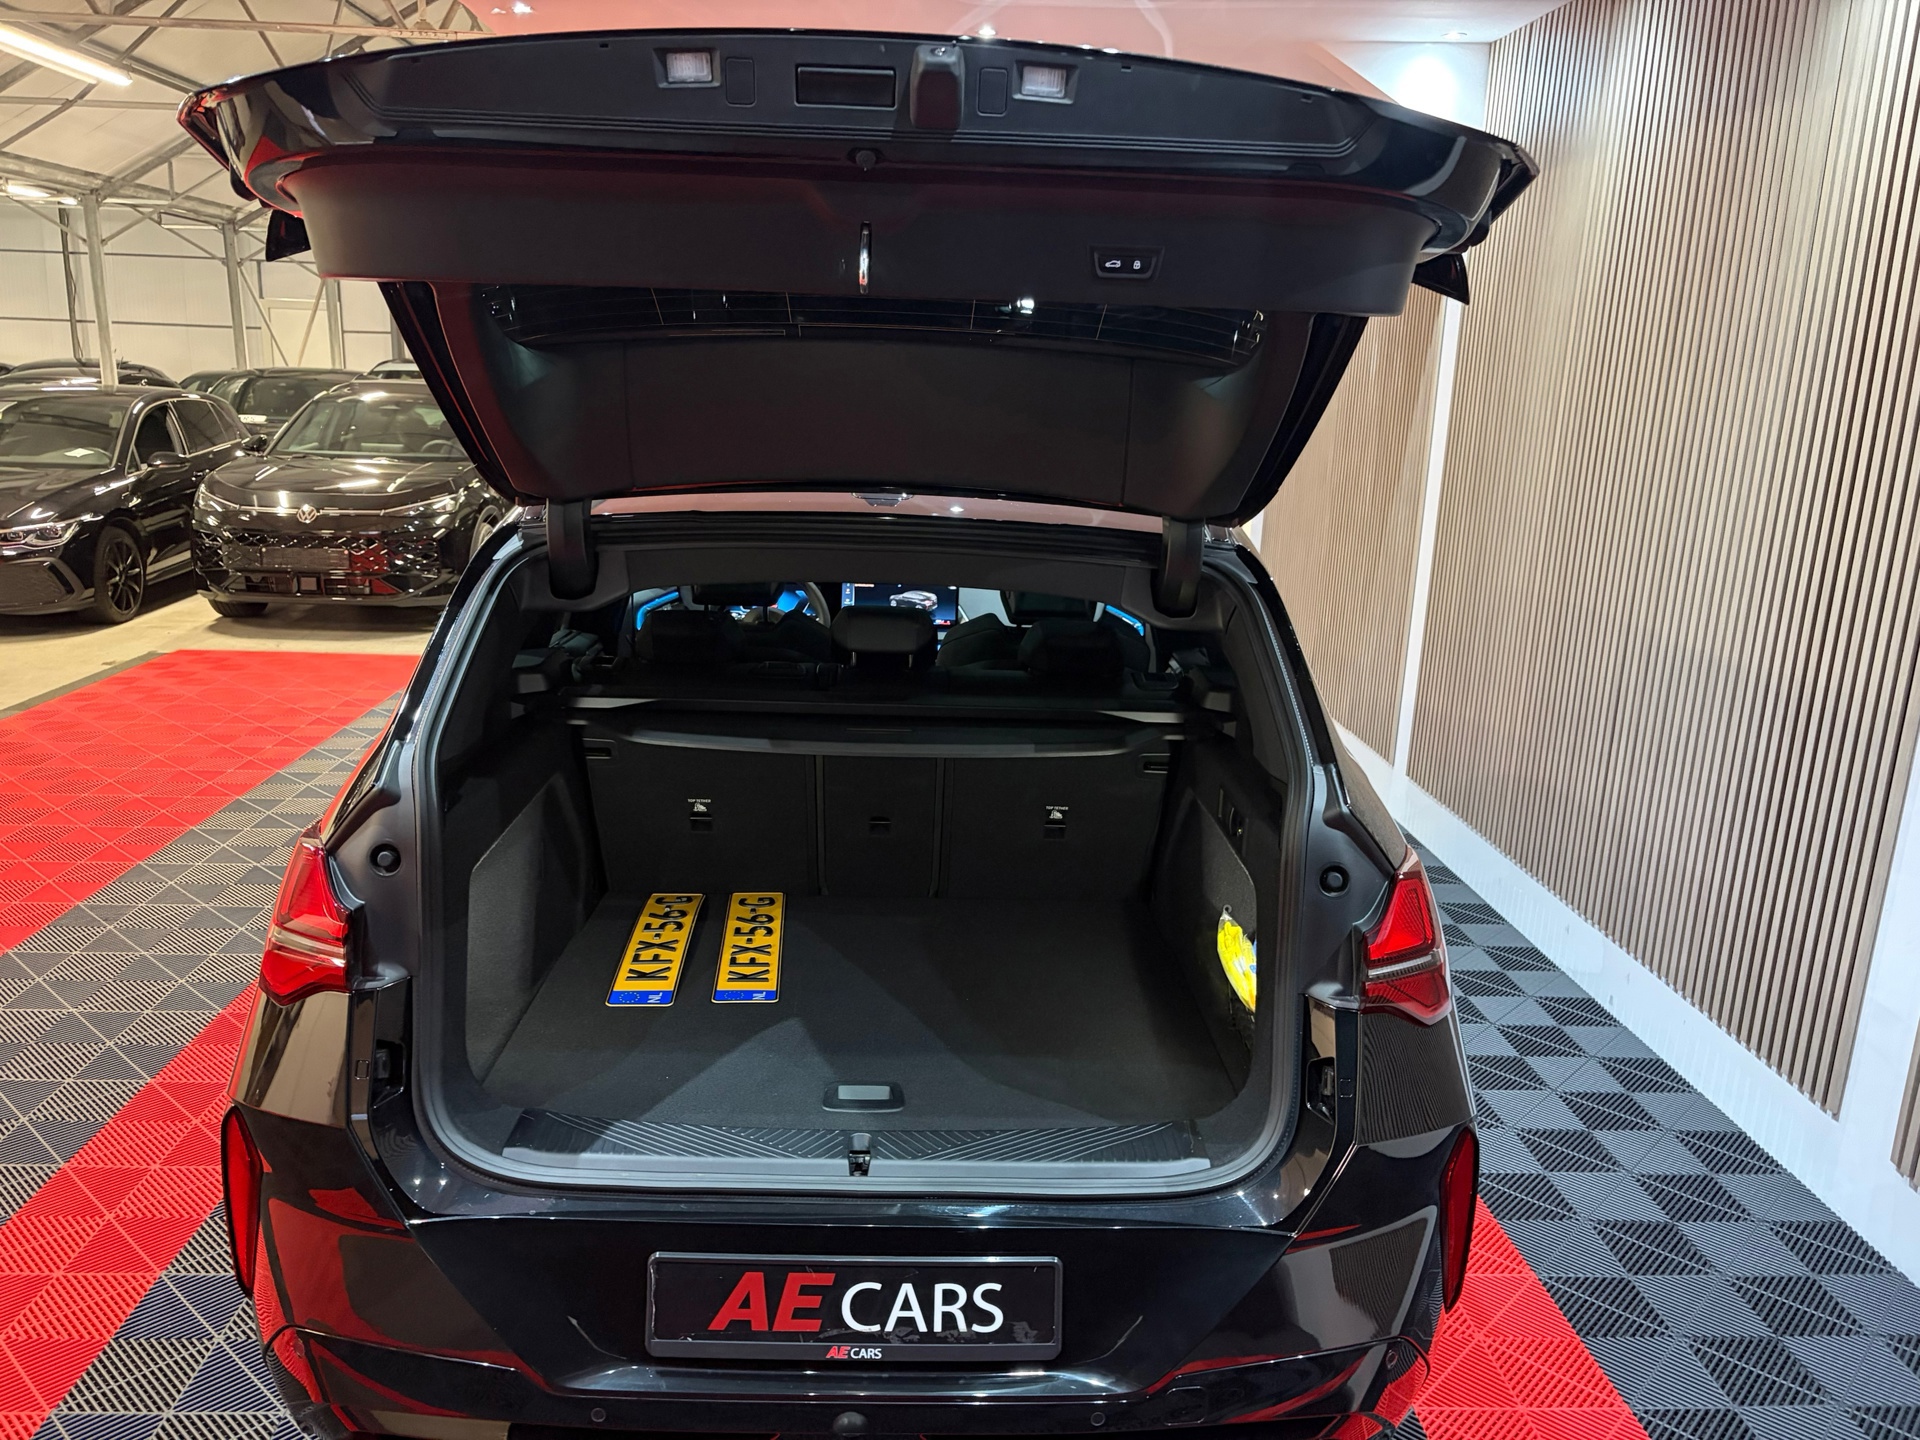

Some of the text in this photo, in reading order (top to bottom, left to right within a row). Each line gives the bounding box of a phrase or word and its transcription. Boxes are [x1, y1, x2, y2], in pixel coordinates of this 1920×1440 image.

[625, 896, 693, 982] KFX-56-G
[727, 896, 776, 983] KFX-56-G
[647, 992, 663, 1003] NL
[752, 991, 766, 1000] NL
[707, 1271, 1004, 1333] AE CARS
[825, 1345, 882, 1359] AE CARS
